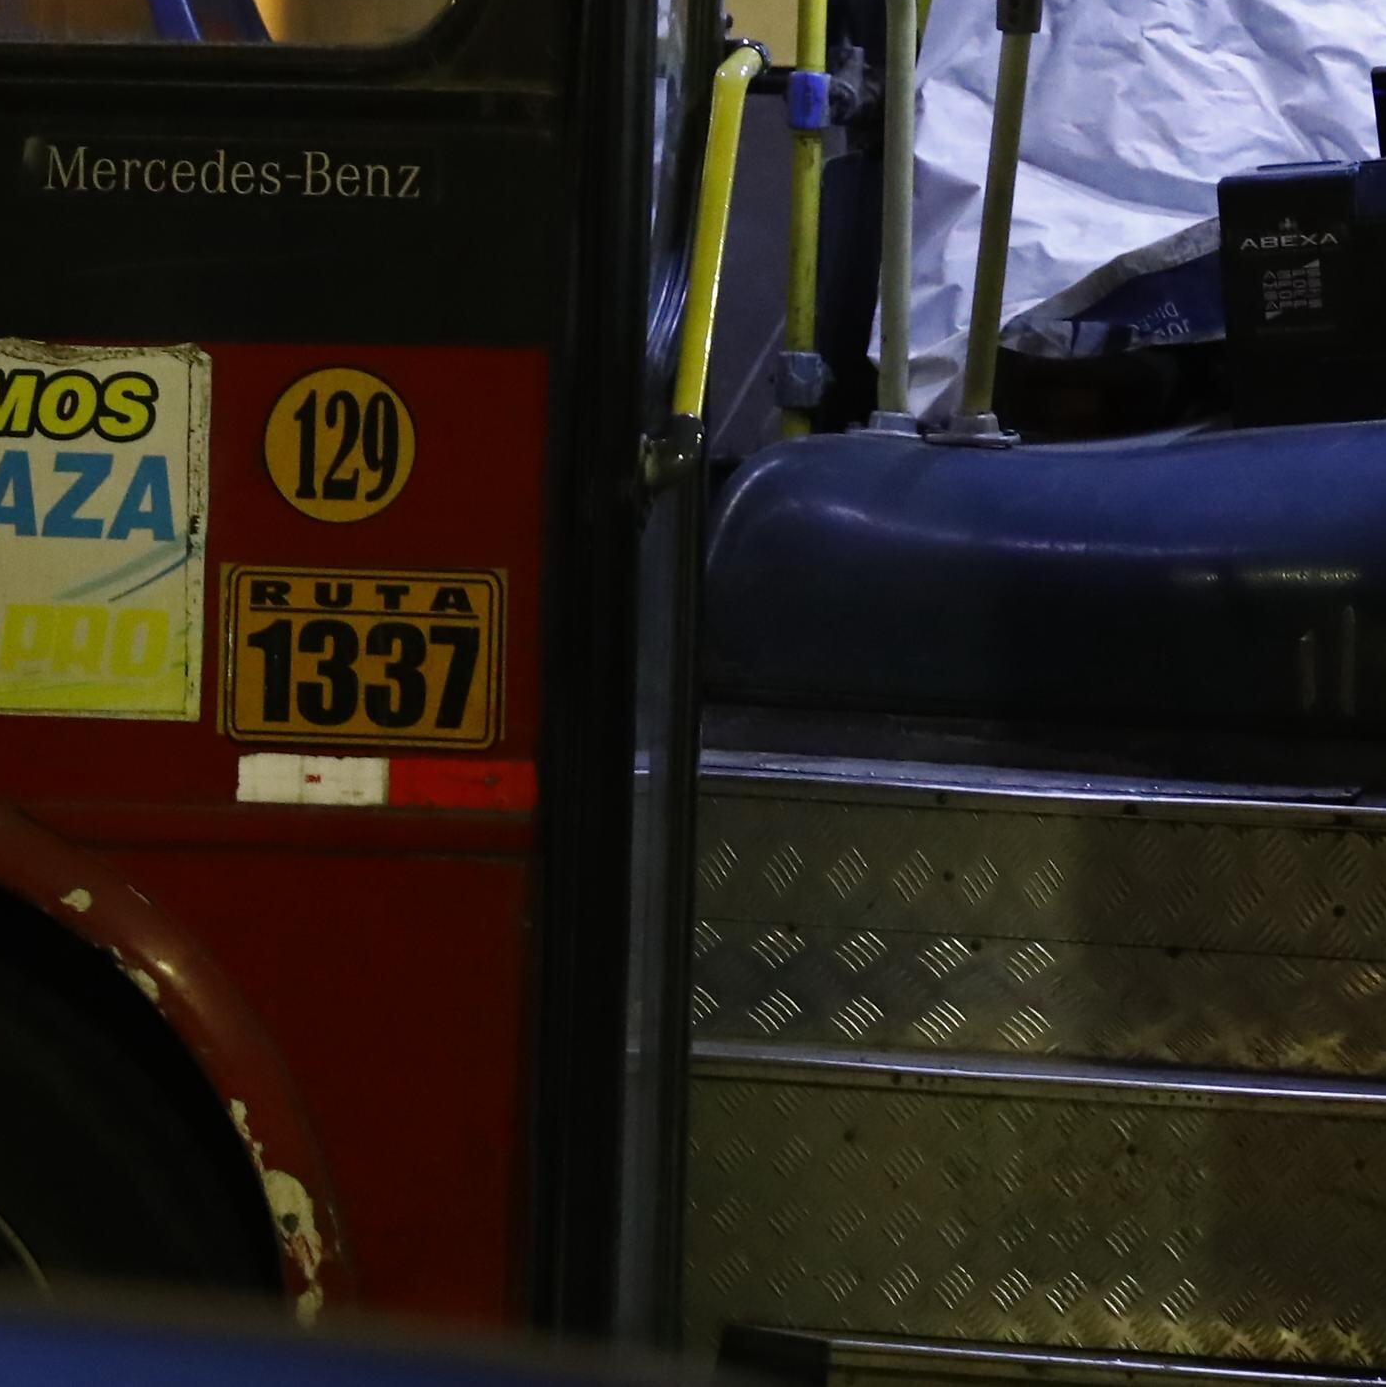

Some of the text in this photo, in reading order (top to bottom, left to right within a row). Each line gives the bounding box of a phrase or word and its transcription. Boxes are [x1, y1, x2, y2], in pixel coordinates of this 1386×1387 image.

[43, 145, 422, 200] Mercedes-Benz
[1239, 232, 1339, 251] ABEXA
[294, 389, 400, 504] 129
[250, 580, 475, 612] RUTA
[246, 617, 481, 730] 1337
